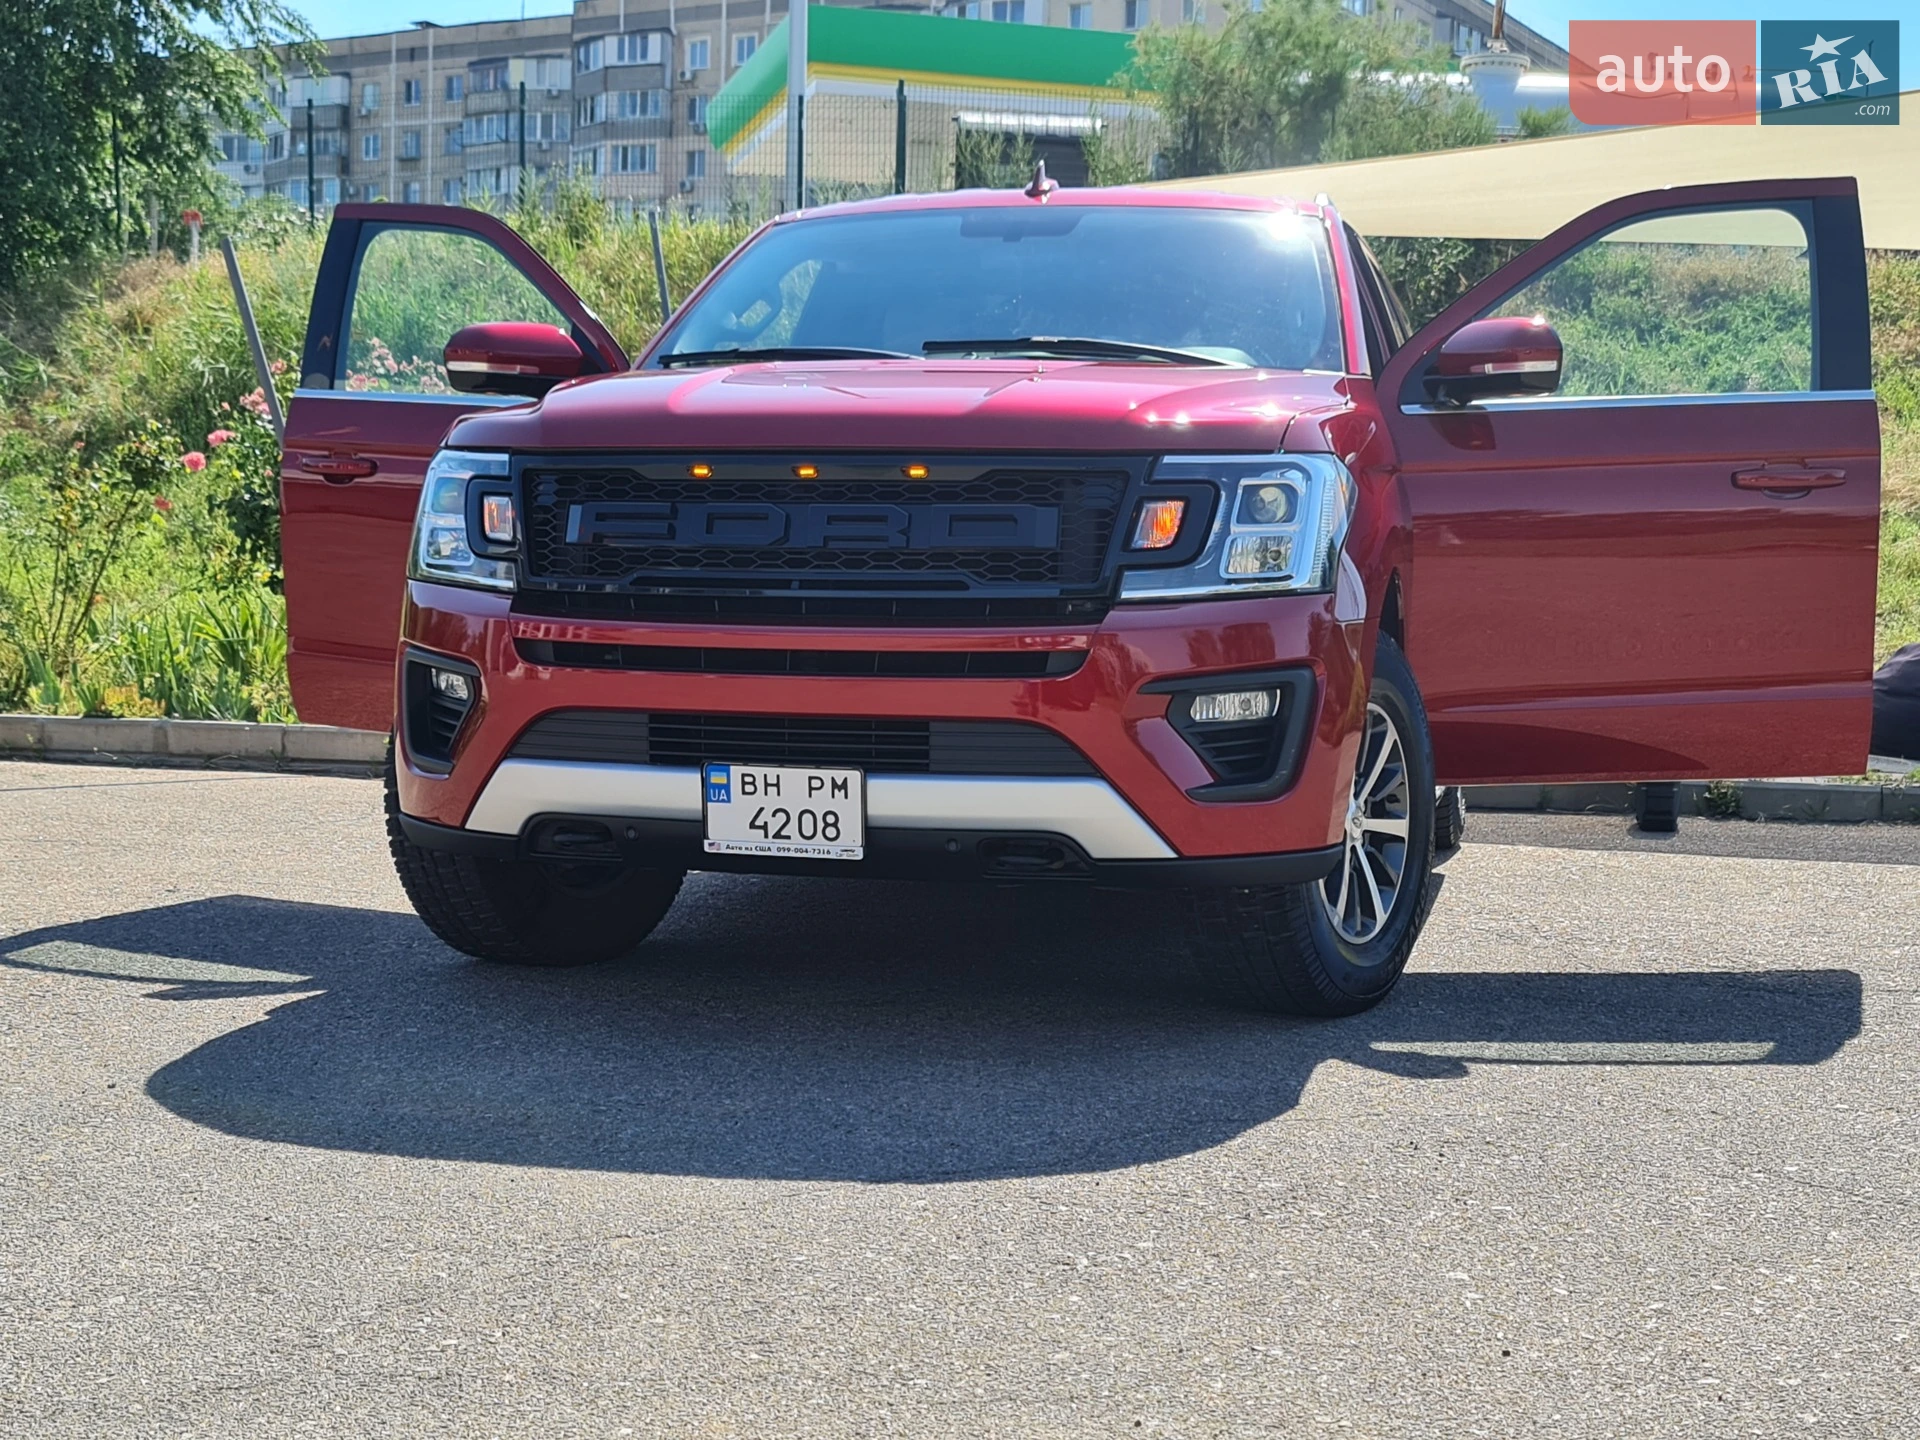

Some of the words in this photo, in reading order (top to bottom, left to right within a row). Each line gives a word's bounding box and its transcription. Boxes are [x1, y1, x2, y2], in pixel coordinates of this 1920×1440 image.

[565, 501, 1061, 550] FORD
[710, 789, 728, 801] UA
[740, 773, 781, 797] BH
[807, 776, 849, 800] PM
[748, 806, 841, 842] 4208
[754, 845, 772, 853] США
